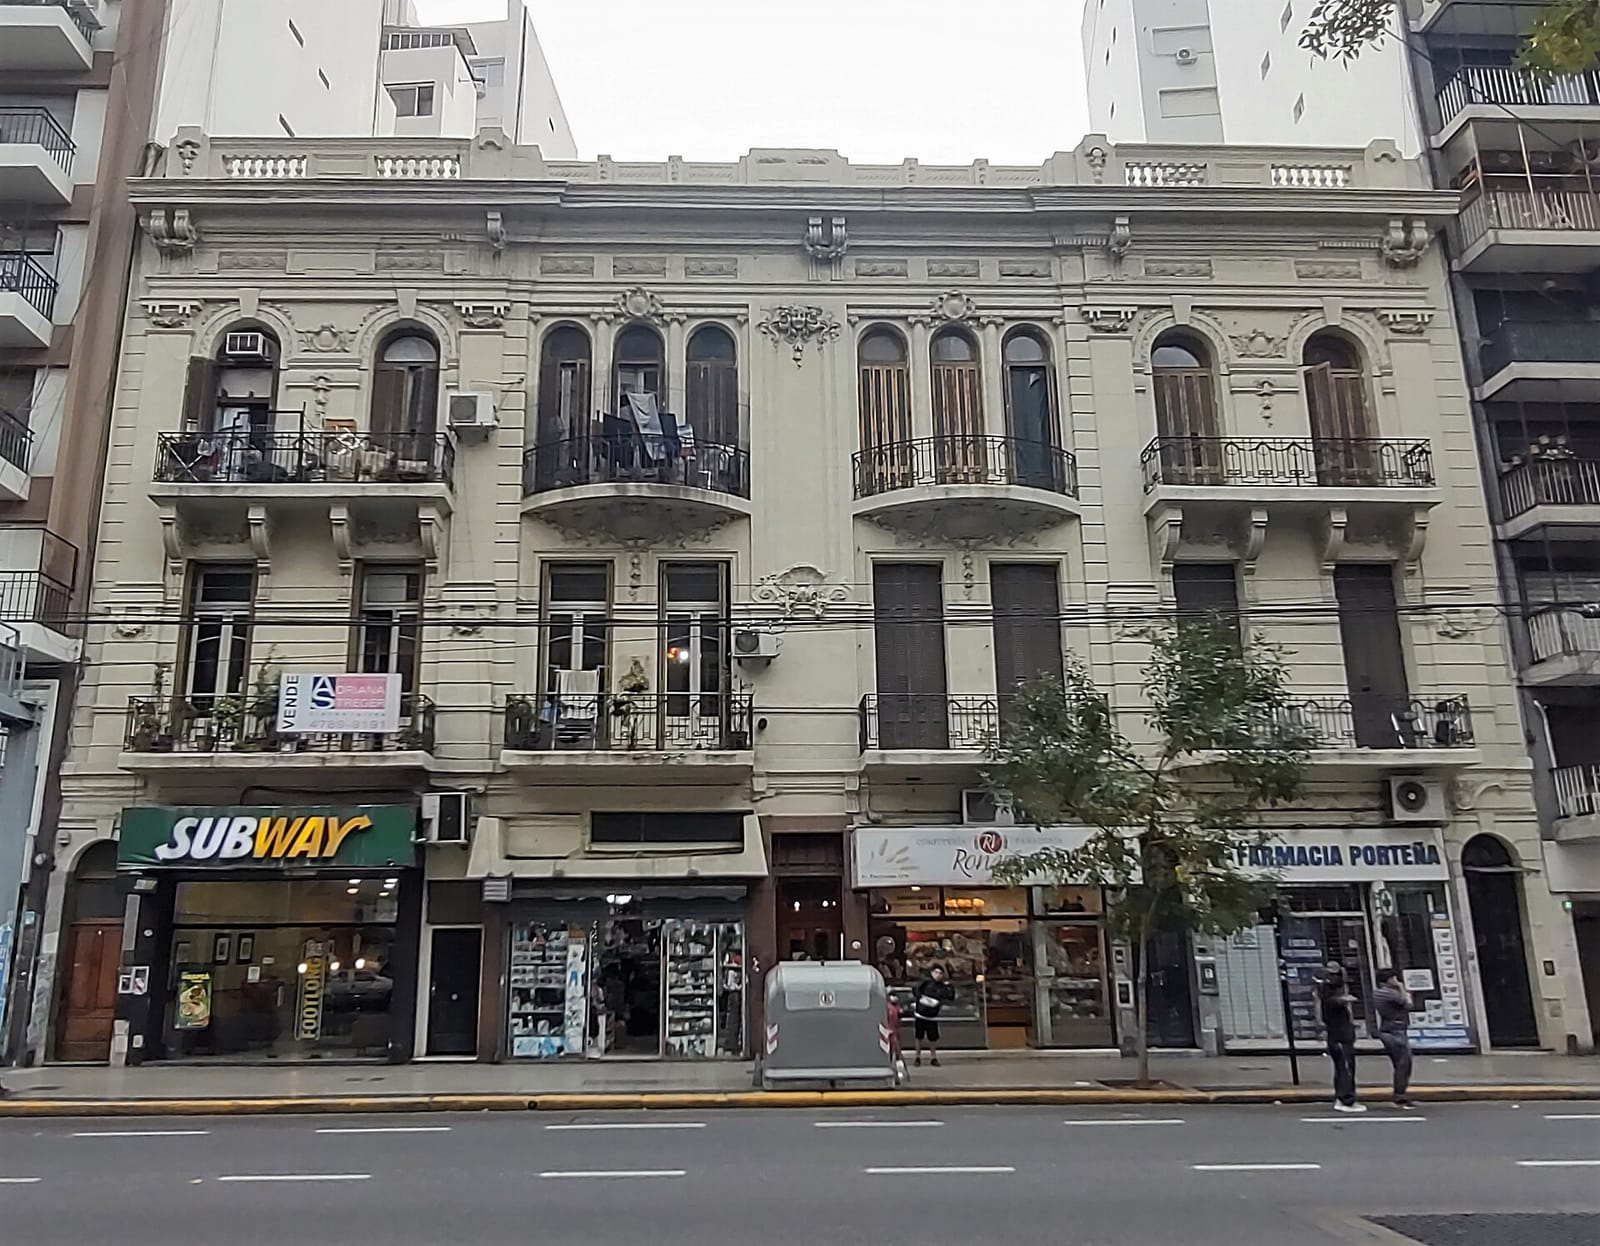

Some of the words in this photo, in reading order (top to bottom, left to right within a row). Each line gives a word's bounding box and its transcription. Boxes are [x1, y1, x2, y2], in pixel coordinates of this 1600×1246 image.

[282, 675, 299, 729] VENDE
[154, 815, 373, 861] SUBWAY
[1238, 845, 1343, 867] FARMACIA
[1350, 841, 1441, 866] PORTEÑA
[302, 957, 321, 1040] FOOTLONG
